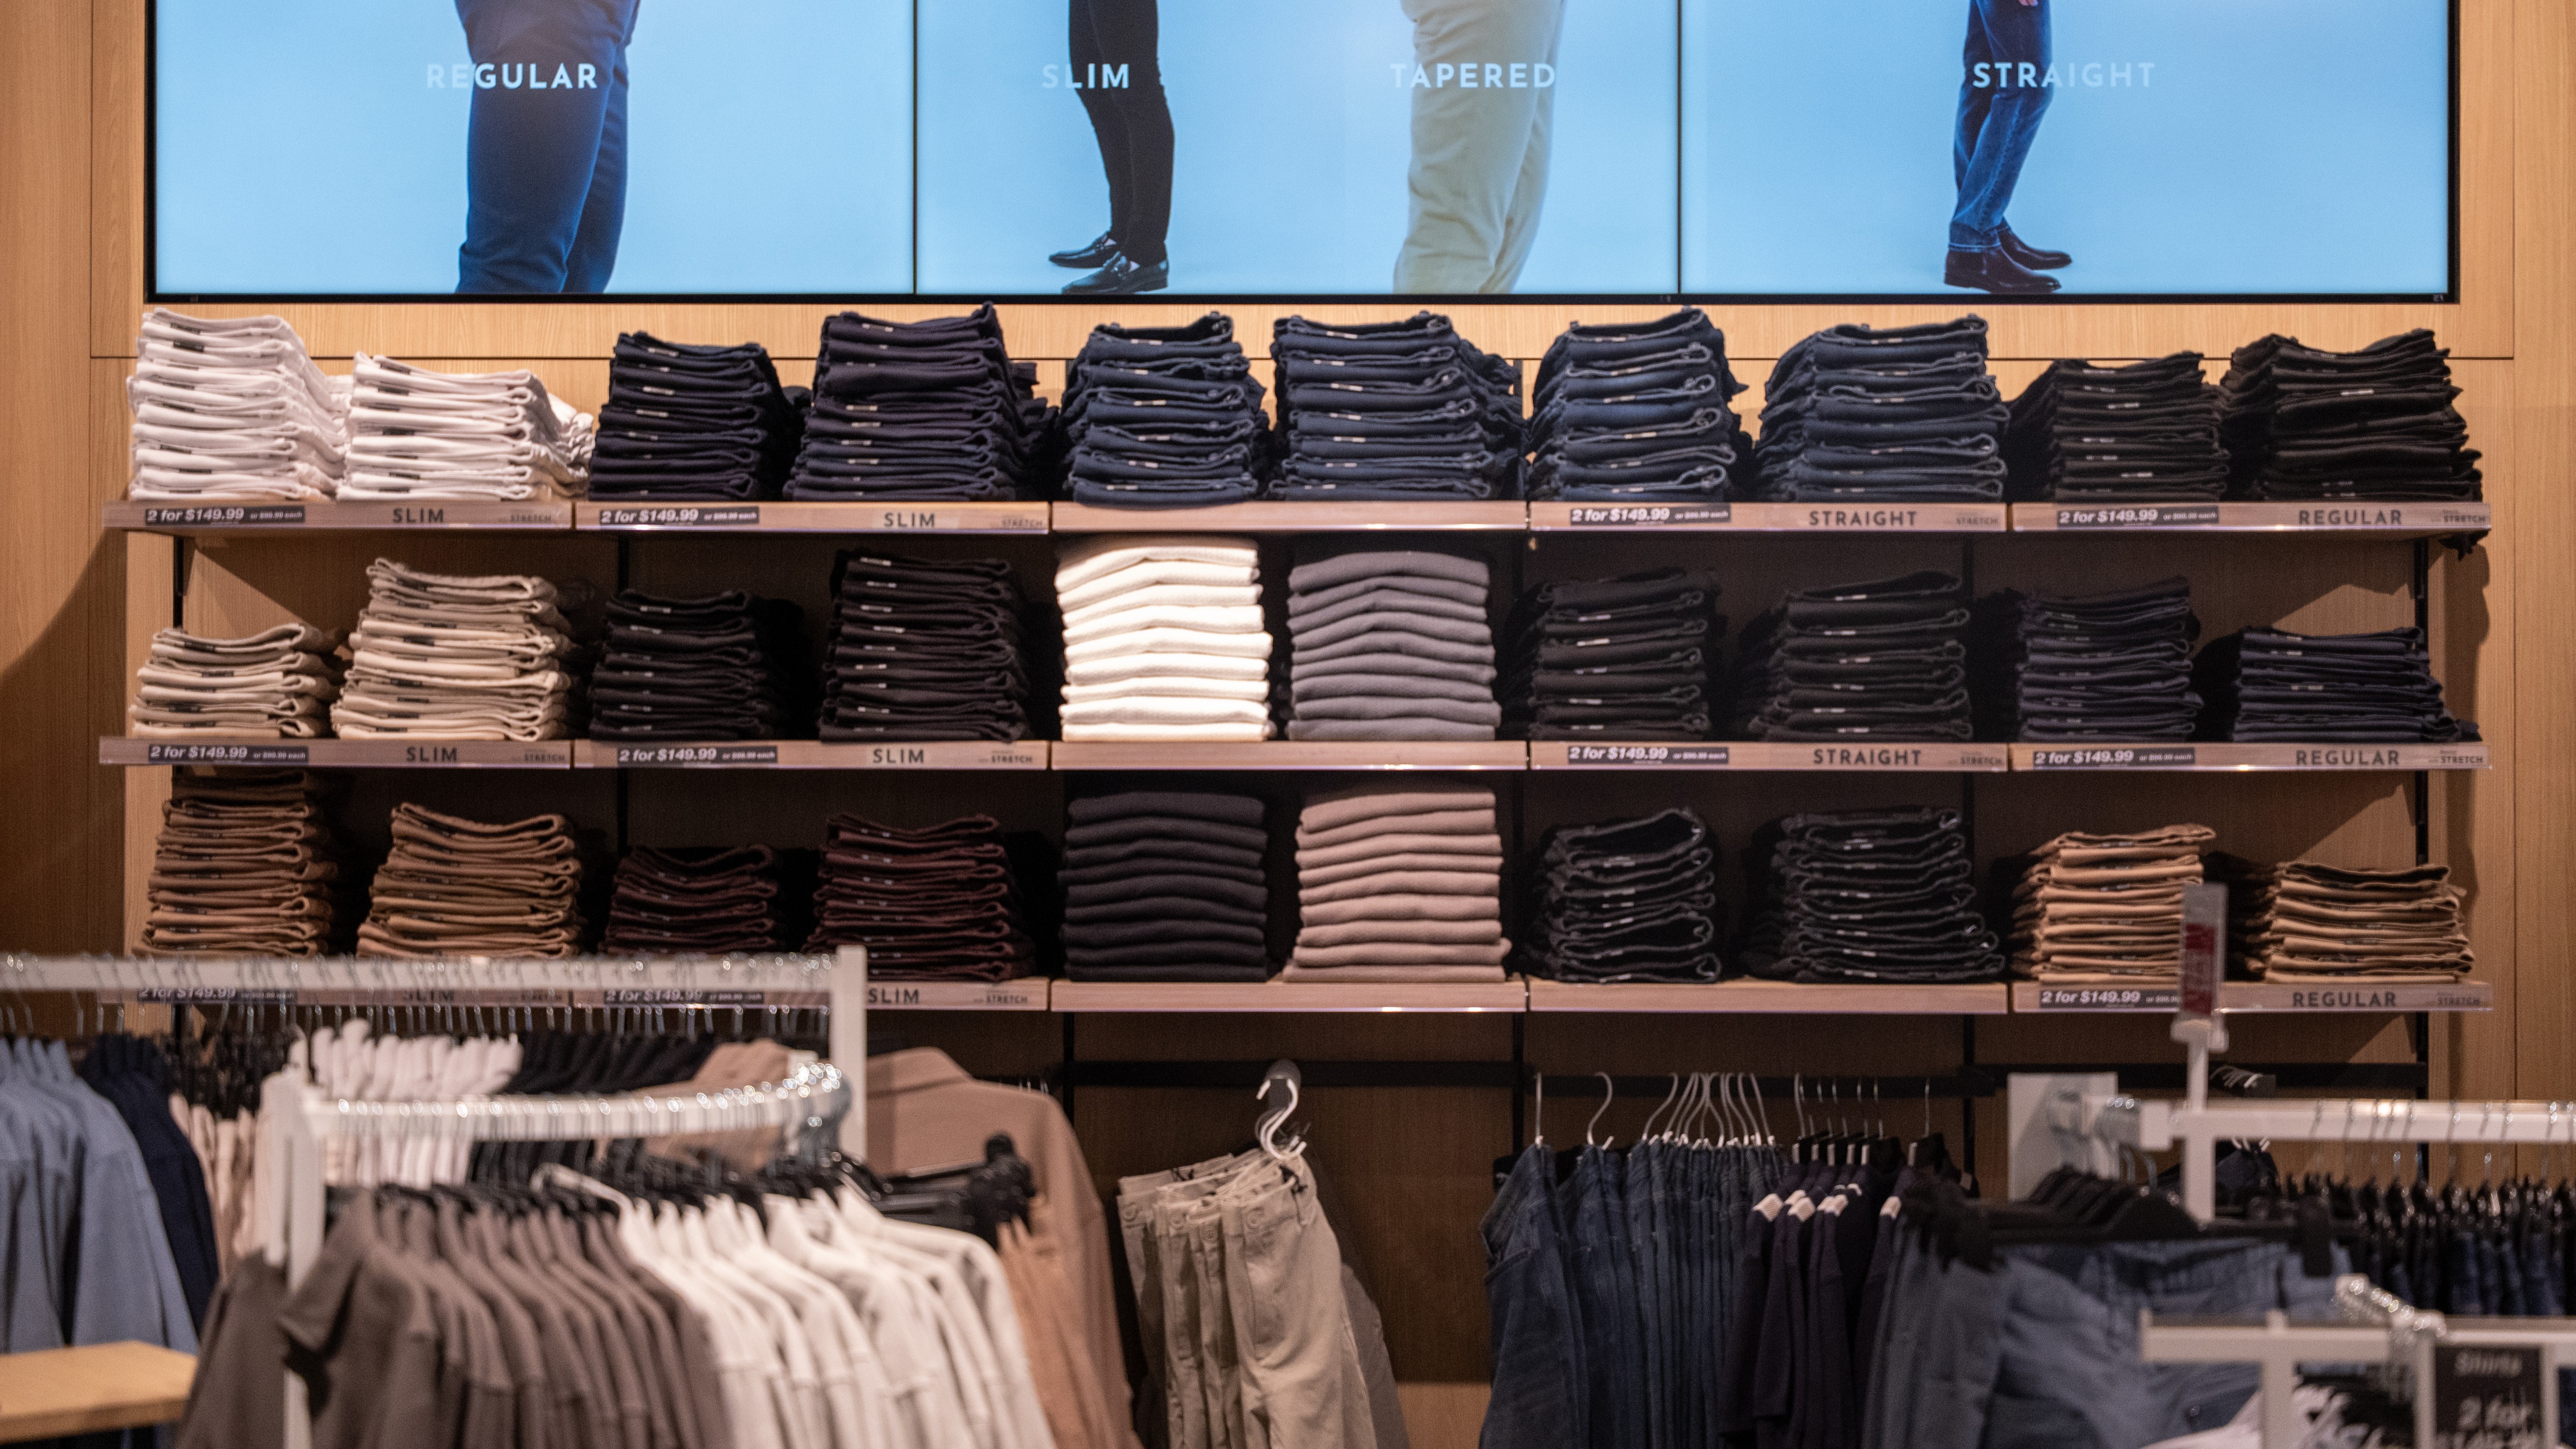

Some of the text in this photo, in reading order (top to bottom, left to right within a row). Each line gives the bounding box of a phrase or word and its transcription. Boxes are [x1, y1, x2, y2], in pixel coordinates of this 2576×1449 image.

[427, 63, 598, 89] REGULAR
[1042, 63, 1129, 89] SLIM
[1390, 63, 1557, 89] TAPERED
[1972, 62, 2155, 89] STRAIGHT
[147, 510, 158, 522] 2
[161, 509, 181, 522] for
[186, 508, 244, 522] $149.99
[393, 508, 444, 523] SLIM
[601, 512, 611, 523] 2
[615, 510, 636, 523] for
[639, 509, 699, 522] $149.99
[884, 513, 935, 527] SLIM
[1572, 510, 1582, 521] 2
[1585, 509, 1607, 522] for
[1609, 508, 1670, 522] $149.99
[1810, 511, 1917, 526] STRAIGHT
[2060, 513, 2070, 523] 2
[2072, 511, 2094, 523] for
[2097, 510, 2158, 522] $149.99
[2299, 510, 2402, 525] REGULAR
[150, 747, 161, 758] 2
[164, 746, 185, 758] for
[188, 746, 247, 758] $149.99
[406, 747, 457, 762] SLIM
[619, 750, 629, 761] 2
[632, 748, 653, 761] for
[657, 748, 717, 761] $149.99
[873, 749, 924, 764] SLIM
[1570, 747, 1580, 759] 2
[1583, 746, 1604, 759] for
[1608, 746, 1668, 760] $149.99
[1814, 749, 1921, 765] STRAIGHT
[2035, 753, 2046, 764] 2
[2049, 751, 2069, 764] for
[2073, 750, 2134, 764] $149.99
[2296, 750, 2399, 765] REGULAR
[867, 988, 920, 1004] SLIM
[2042, 991, 2053, 1003] 2
[2055, 991, 2078, 1003] for
[2080, 991, 2141, 1004] $149.99
[2292, 992, 2397, 1007] REGULAR
